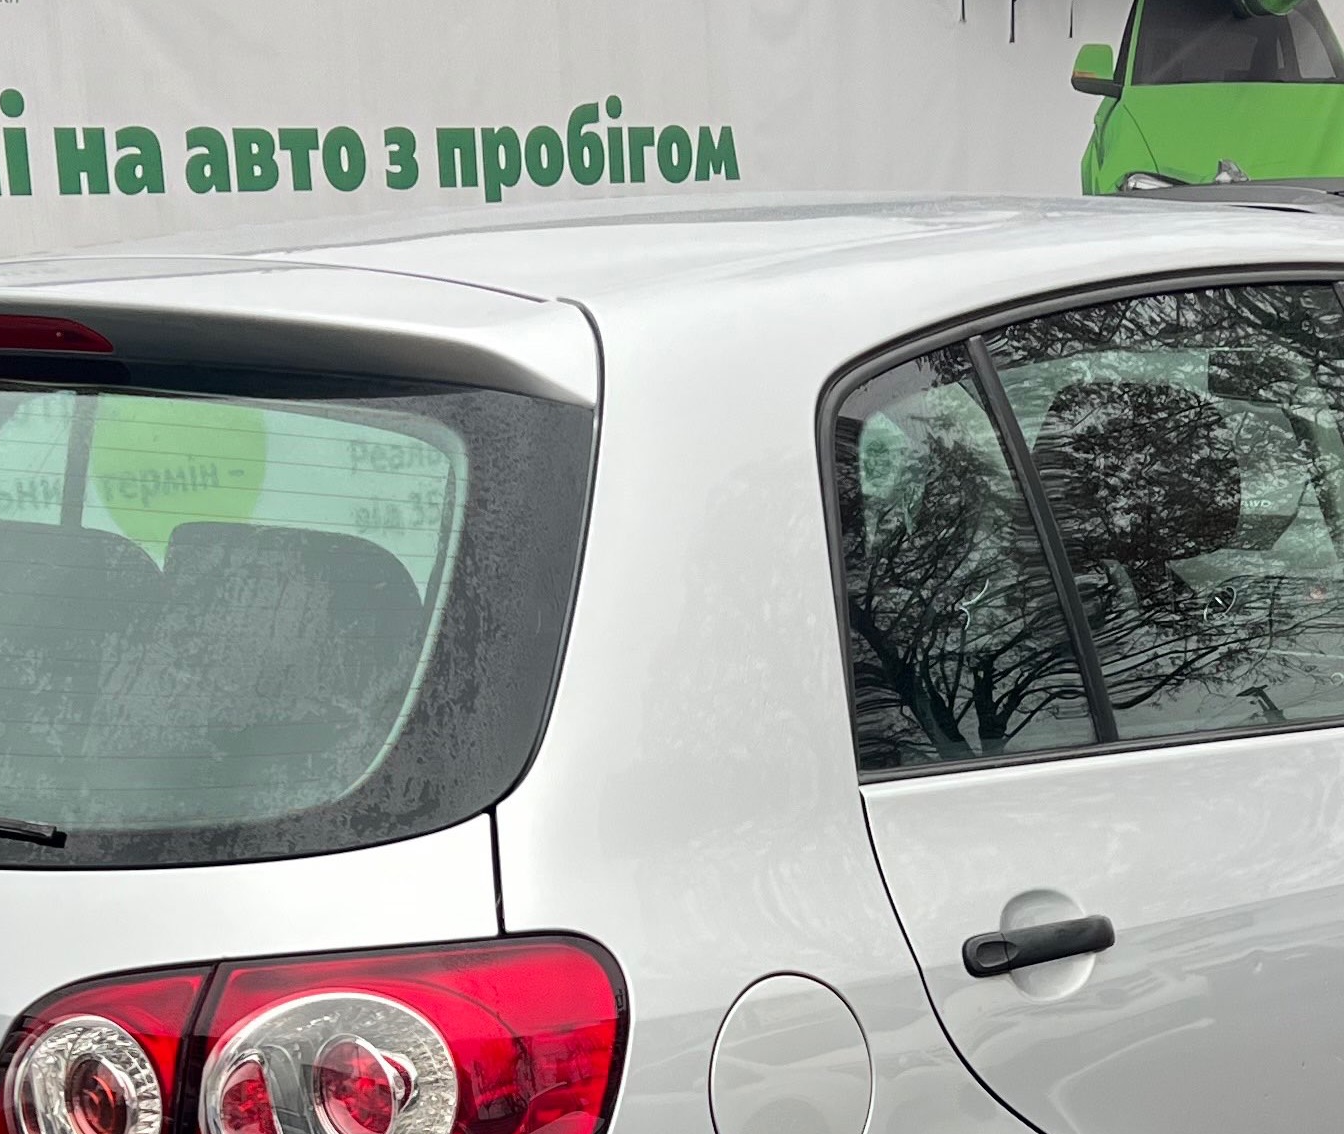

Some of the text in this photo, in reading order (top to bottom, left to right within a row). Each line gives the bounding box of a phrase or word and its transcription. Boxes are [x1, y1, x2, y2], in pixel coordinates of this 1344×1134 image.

[54, 126, 165, 196] на
[185, 125, 366, 194] авто
[383, 126, 419, 190] з
[436, 95, 741, 203] пробігом
